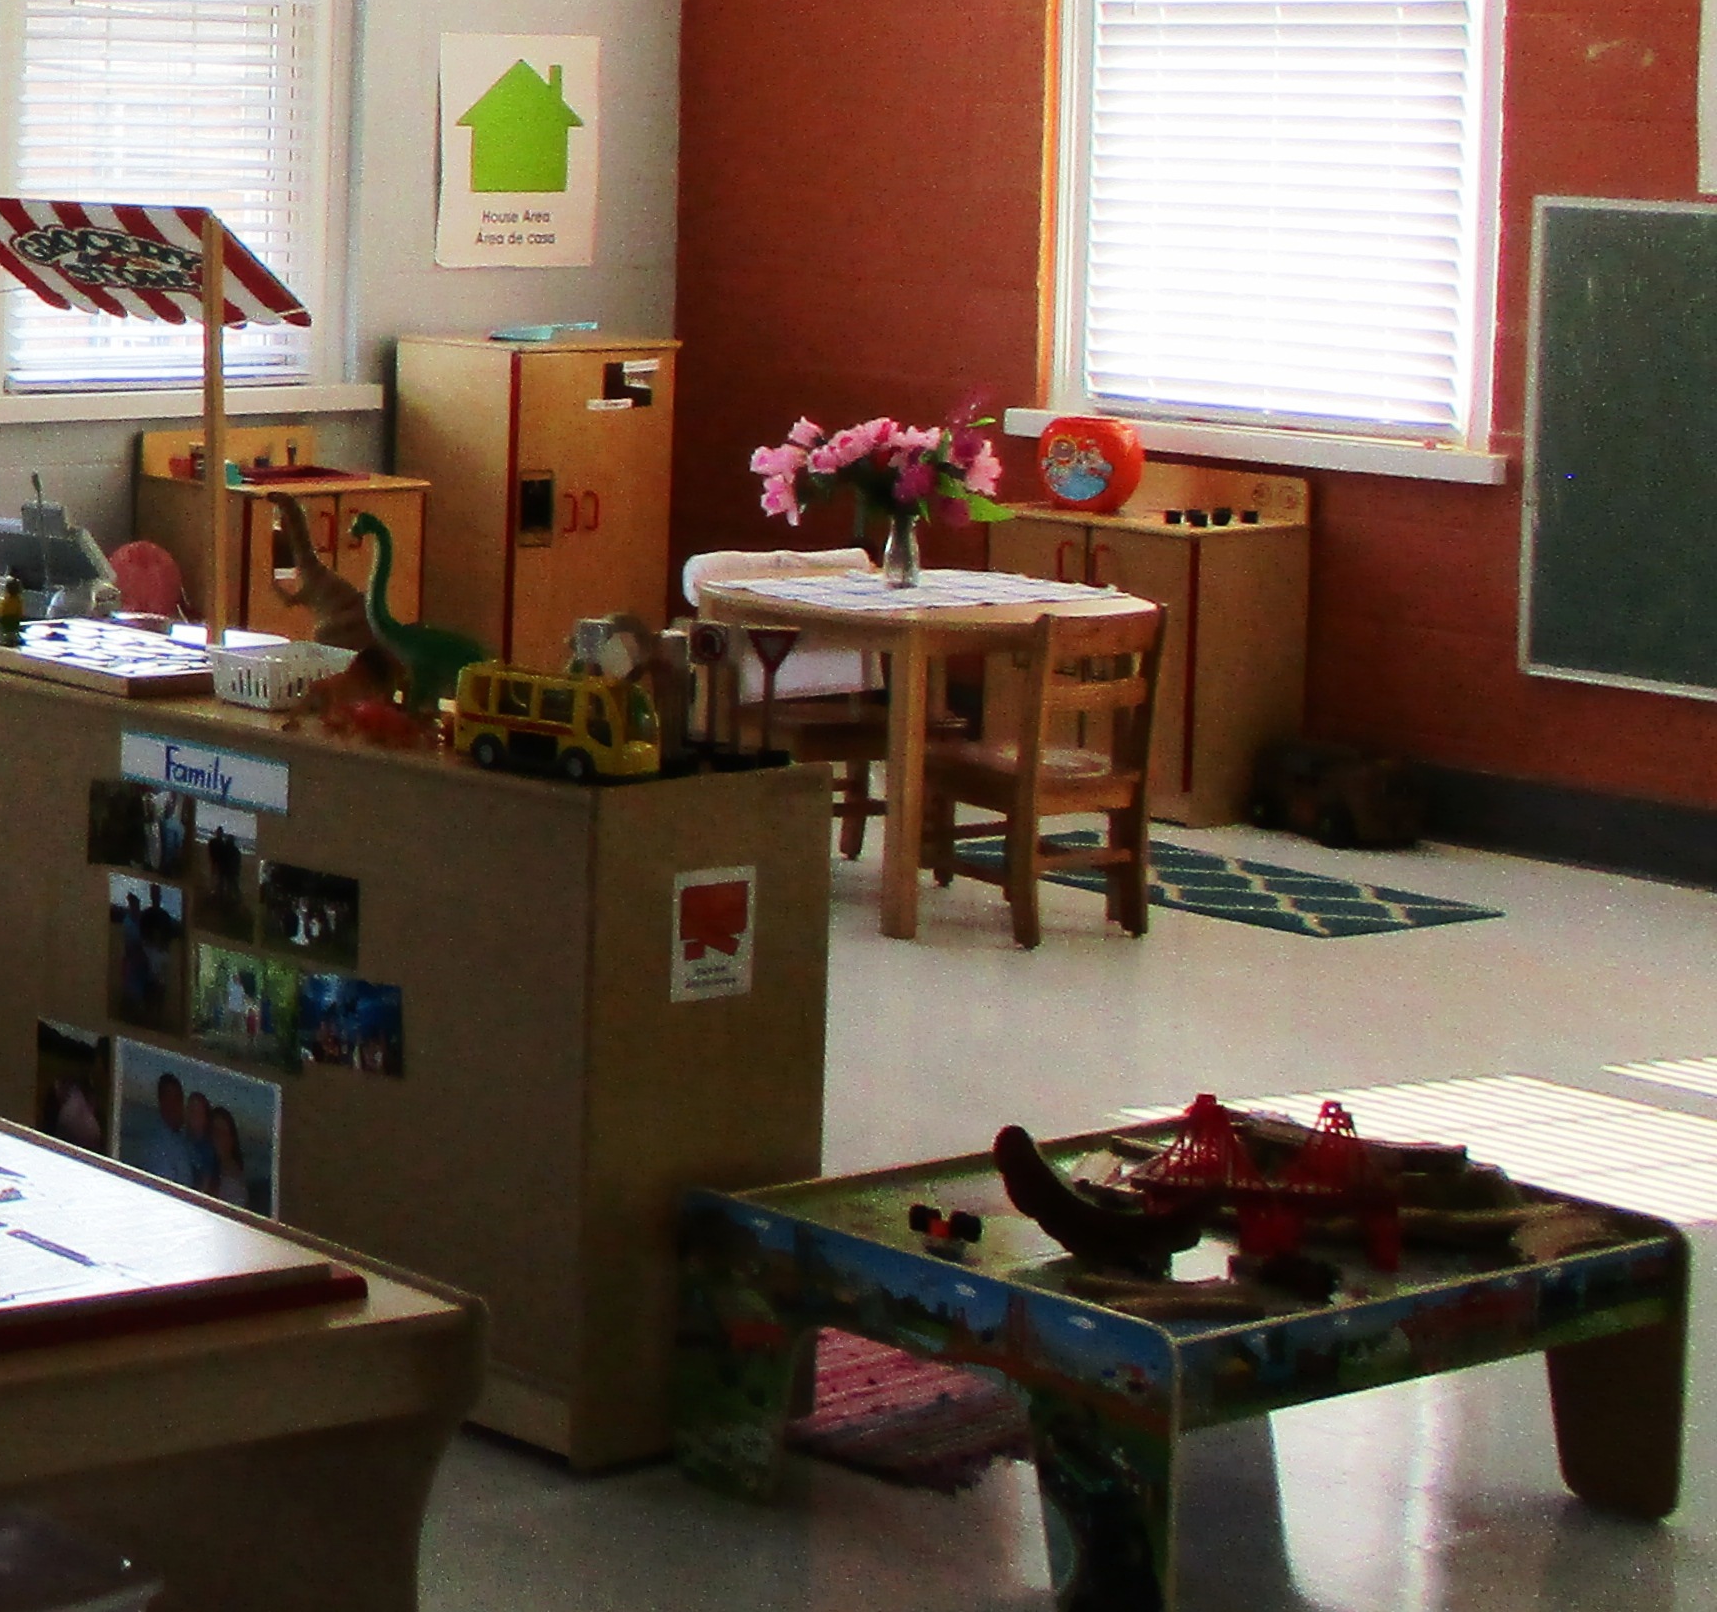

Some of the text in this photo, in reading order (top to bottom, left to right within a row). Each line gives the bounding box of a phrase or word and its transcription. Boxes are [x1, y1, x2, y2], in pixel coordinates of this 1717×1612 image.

[482, 210, 550, 223] House Area
[15, 228, 203, 271] GROCERY
[508, 232, 523, 244] de
[527, 233, 555, 244] casa
[65, 264, 195, 287] STORE
[165, 745, 232, 800] Family
